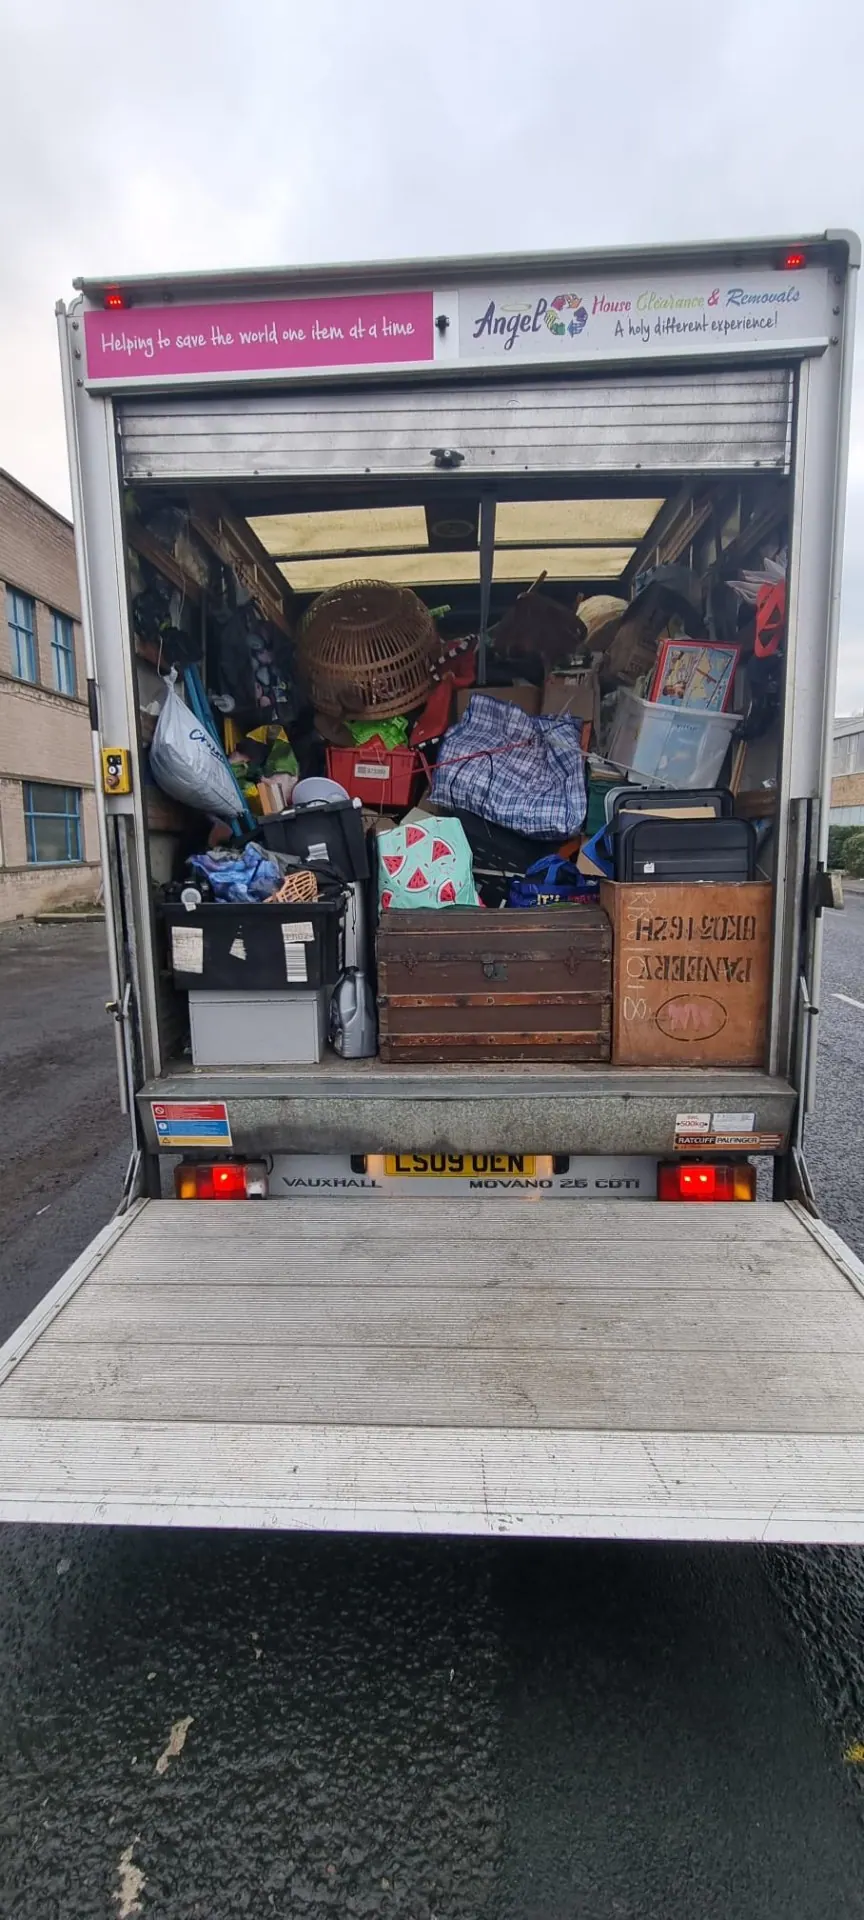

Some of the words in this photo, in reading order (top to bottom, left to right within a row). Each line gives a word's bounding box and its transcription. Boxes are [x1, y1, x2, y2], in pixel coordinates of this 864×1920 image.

[592, 295, 632, 315] House
[636, 289, 705, 312] Clearance
[708, 288, 720, 307] &
[725, 286, 800, 308] Removals
[101, 333, 153, 358] Helping
[157, 337, 172, 350] to
[175, 336, 207, 348] save
[211, 326, 234, 346] the
[239, 322, 279, 345] world
[282, 328, 307, 341] one
[311, 319, 345, 340] item
[349, 317, 367, 338] at
[368, 324, 378, 338] a
[382, 316, 416, 336] time
[473, 298, 548, 350] Angel
[614, 323, 625, 338] A
[628, 321, 652, 342] holy
[654, 317, 709, 332] different
[710, 311, 779, 333] experience!
[282, 1177, 382, 1188] VAUXHALL
[469, 1179, 553, 1189] MOVANO
[595, 1179, 640, 1189] CDTI
